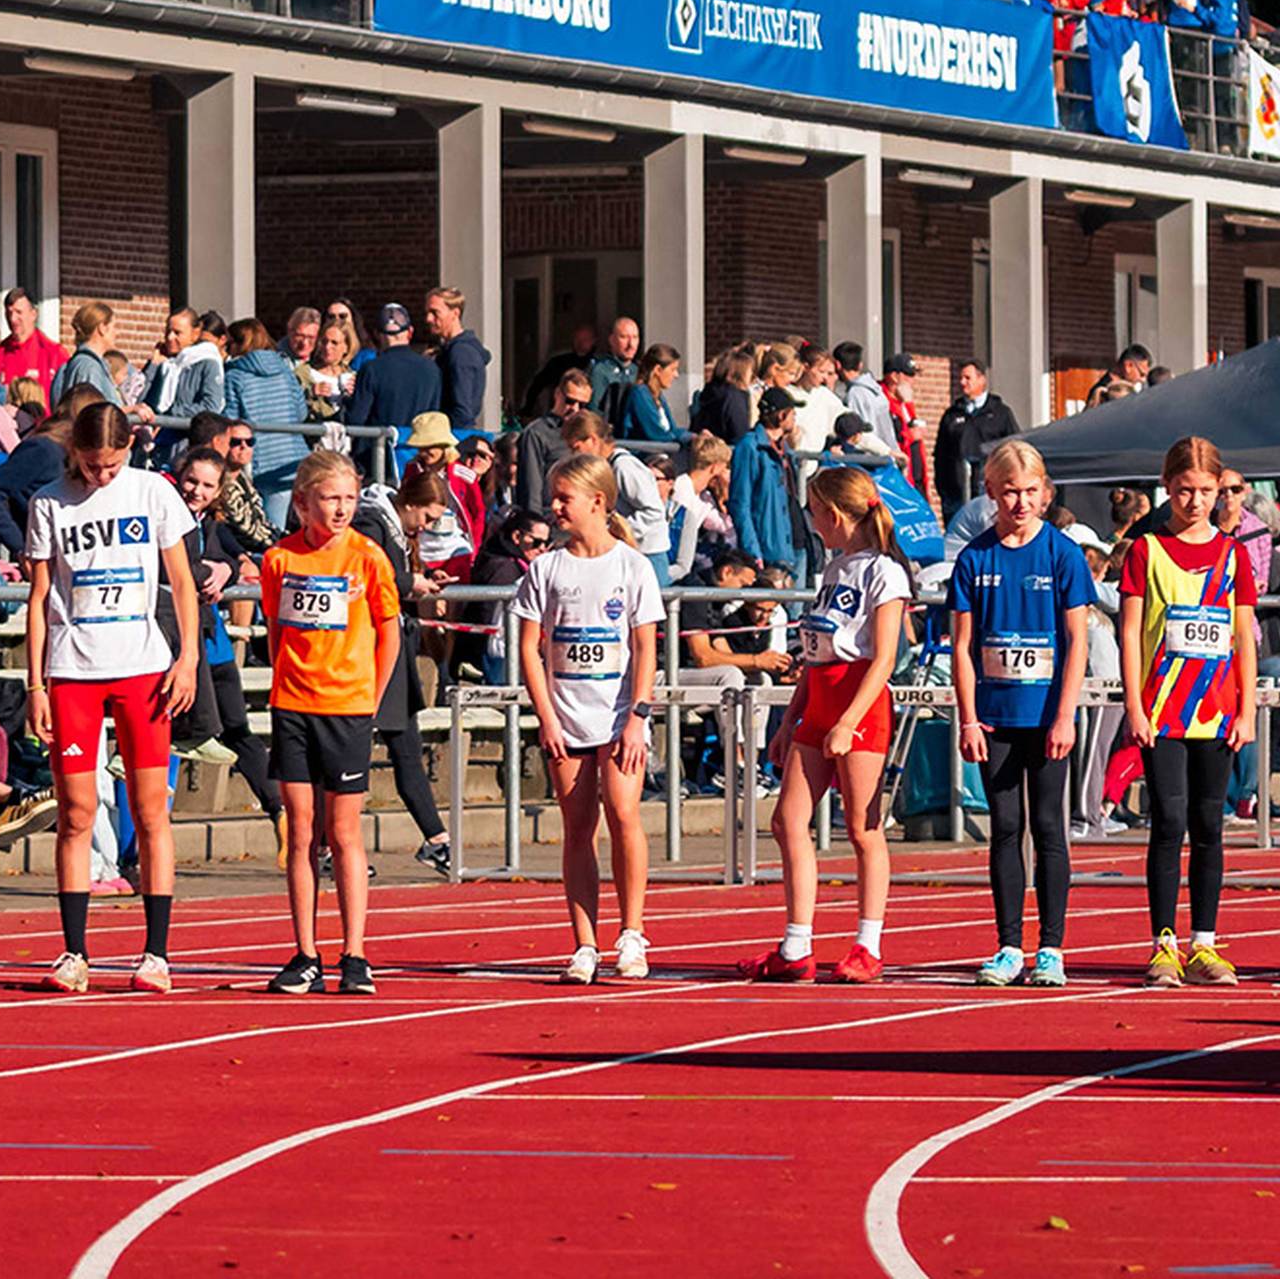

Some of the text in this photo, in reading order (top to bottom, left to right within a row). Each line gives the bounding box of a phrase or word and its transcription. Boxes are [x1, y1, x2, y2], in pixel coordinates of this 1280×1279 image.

[857, 10, 1018, 92] #NURDERHSV
[61, 518, 115, 555] HSV
[98, 586, 123, 605] 77
[293, 592, 331, 612] 879
[1184, 622, 1220, 642] 696
[567, 644, 604, 663] 489
[999, 649, 1036, 668] 176
